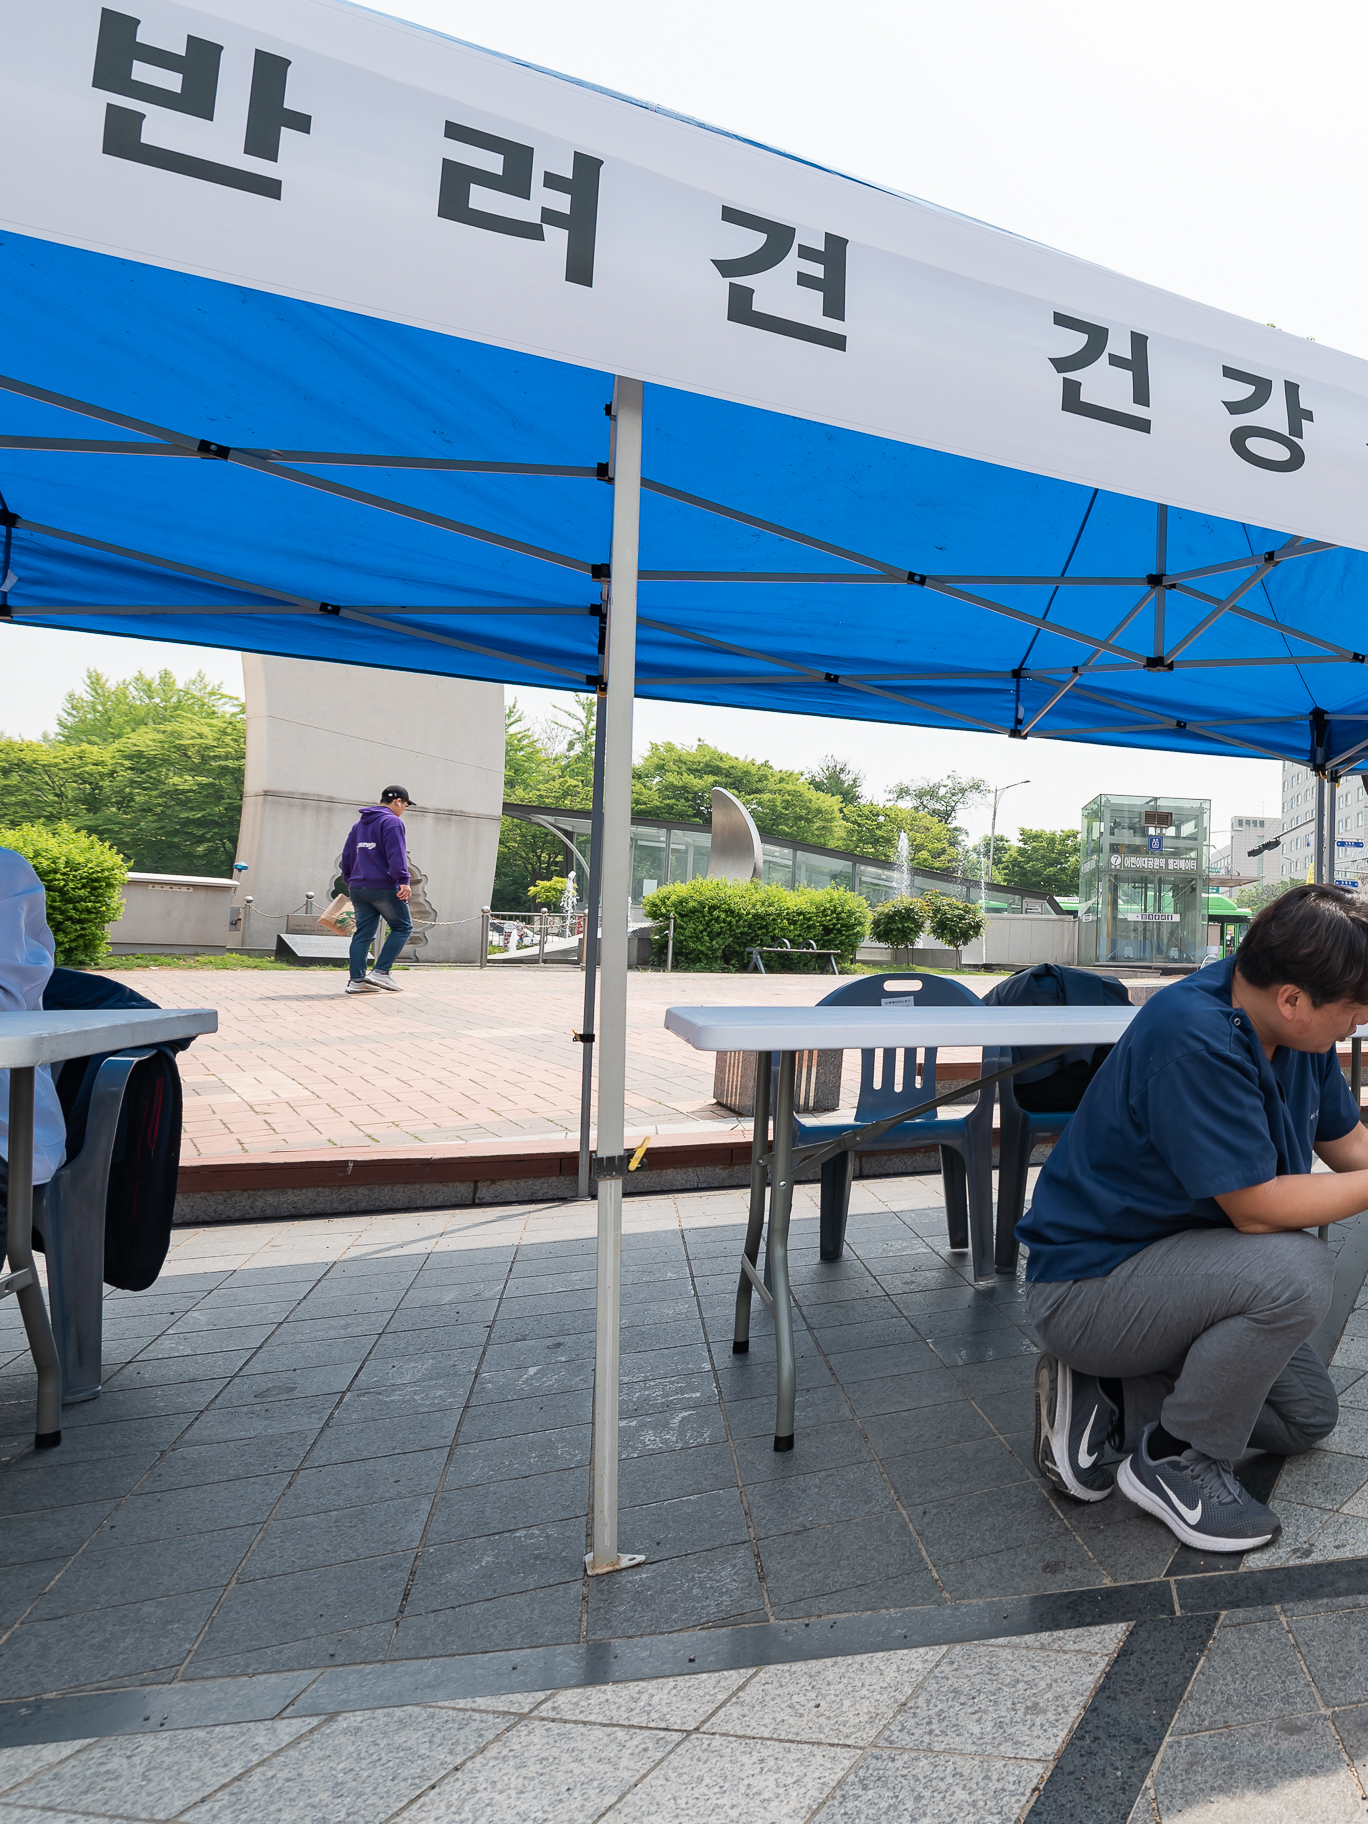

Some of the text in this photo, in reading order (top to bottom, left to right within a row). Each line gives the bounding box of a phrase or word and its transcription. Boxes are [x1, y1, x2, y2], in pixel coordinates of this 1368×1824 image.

[1112, 856, 1197, 870] 7 어린이대공원역 엘리베이터
